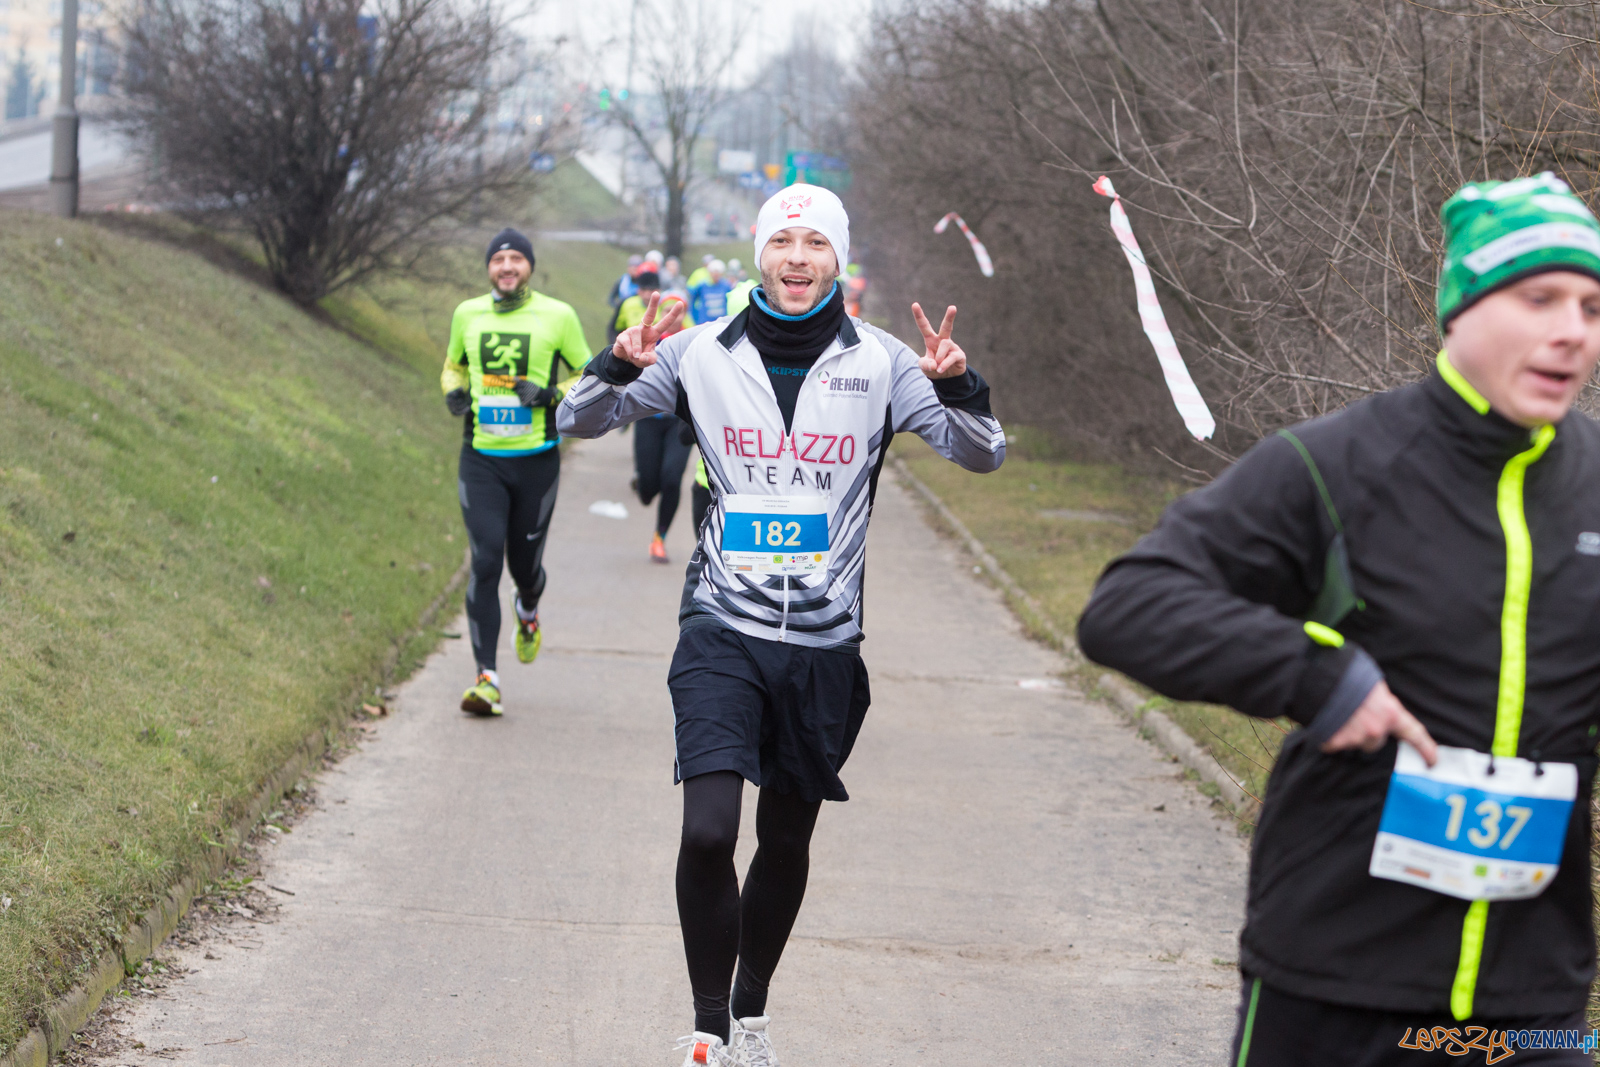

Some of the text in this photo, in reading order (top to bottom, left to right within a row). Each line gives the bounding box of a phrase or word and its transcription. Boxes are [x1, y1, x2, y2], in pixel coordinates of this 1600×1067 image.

[829, 377, 870, 393] REHAU
[492, 408, 516, 423] 171
[723, 426, 856, 465] RELAZZO
[744, 464, 832, 490] TEAM
[751, 520, 802, 547] 182
[1444, 794, 1533, 850] 137
